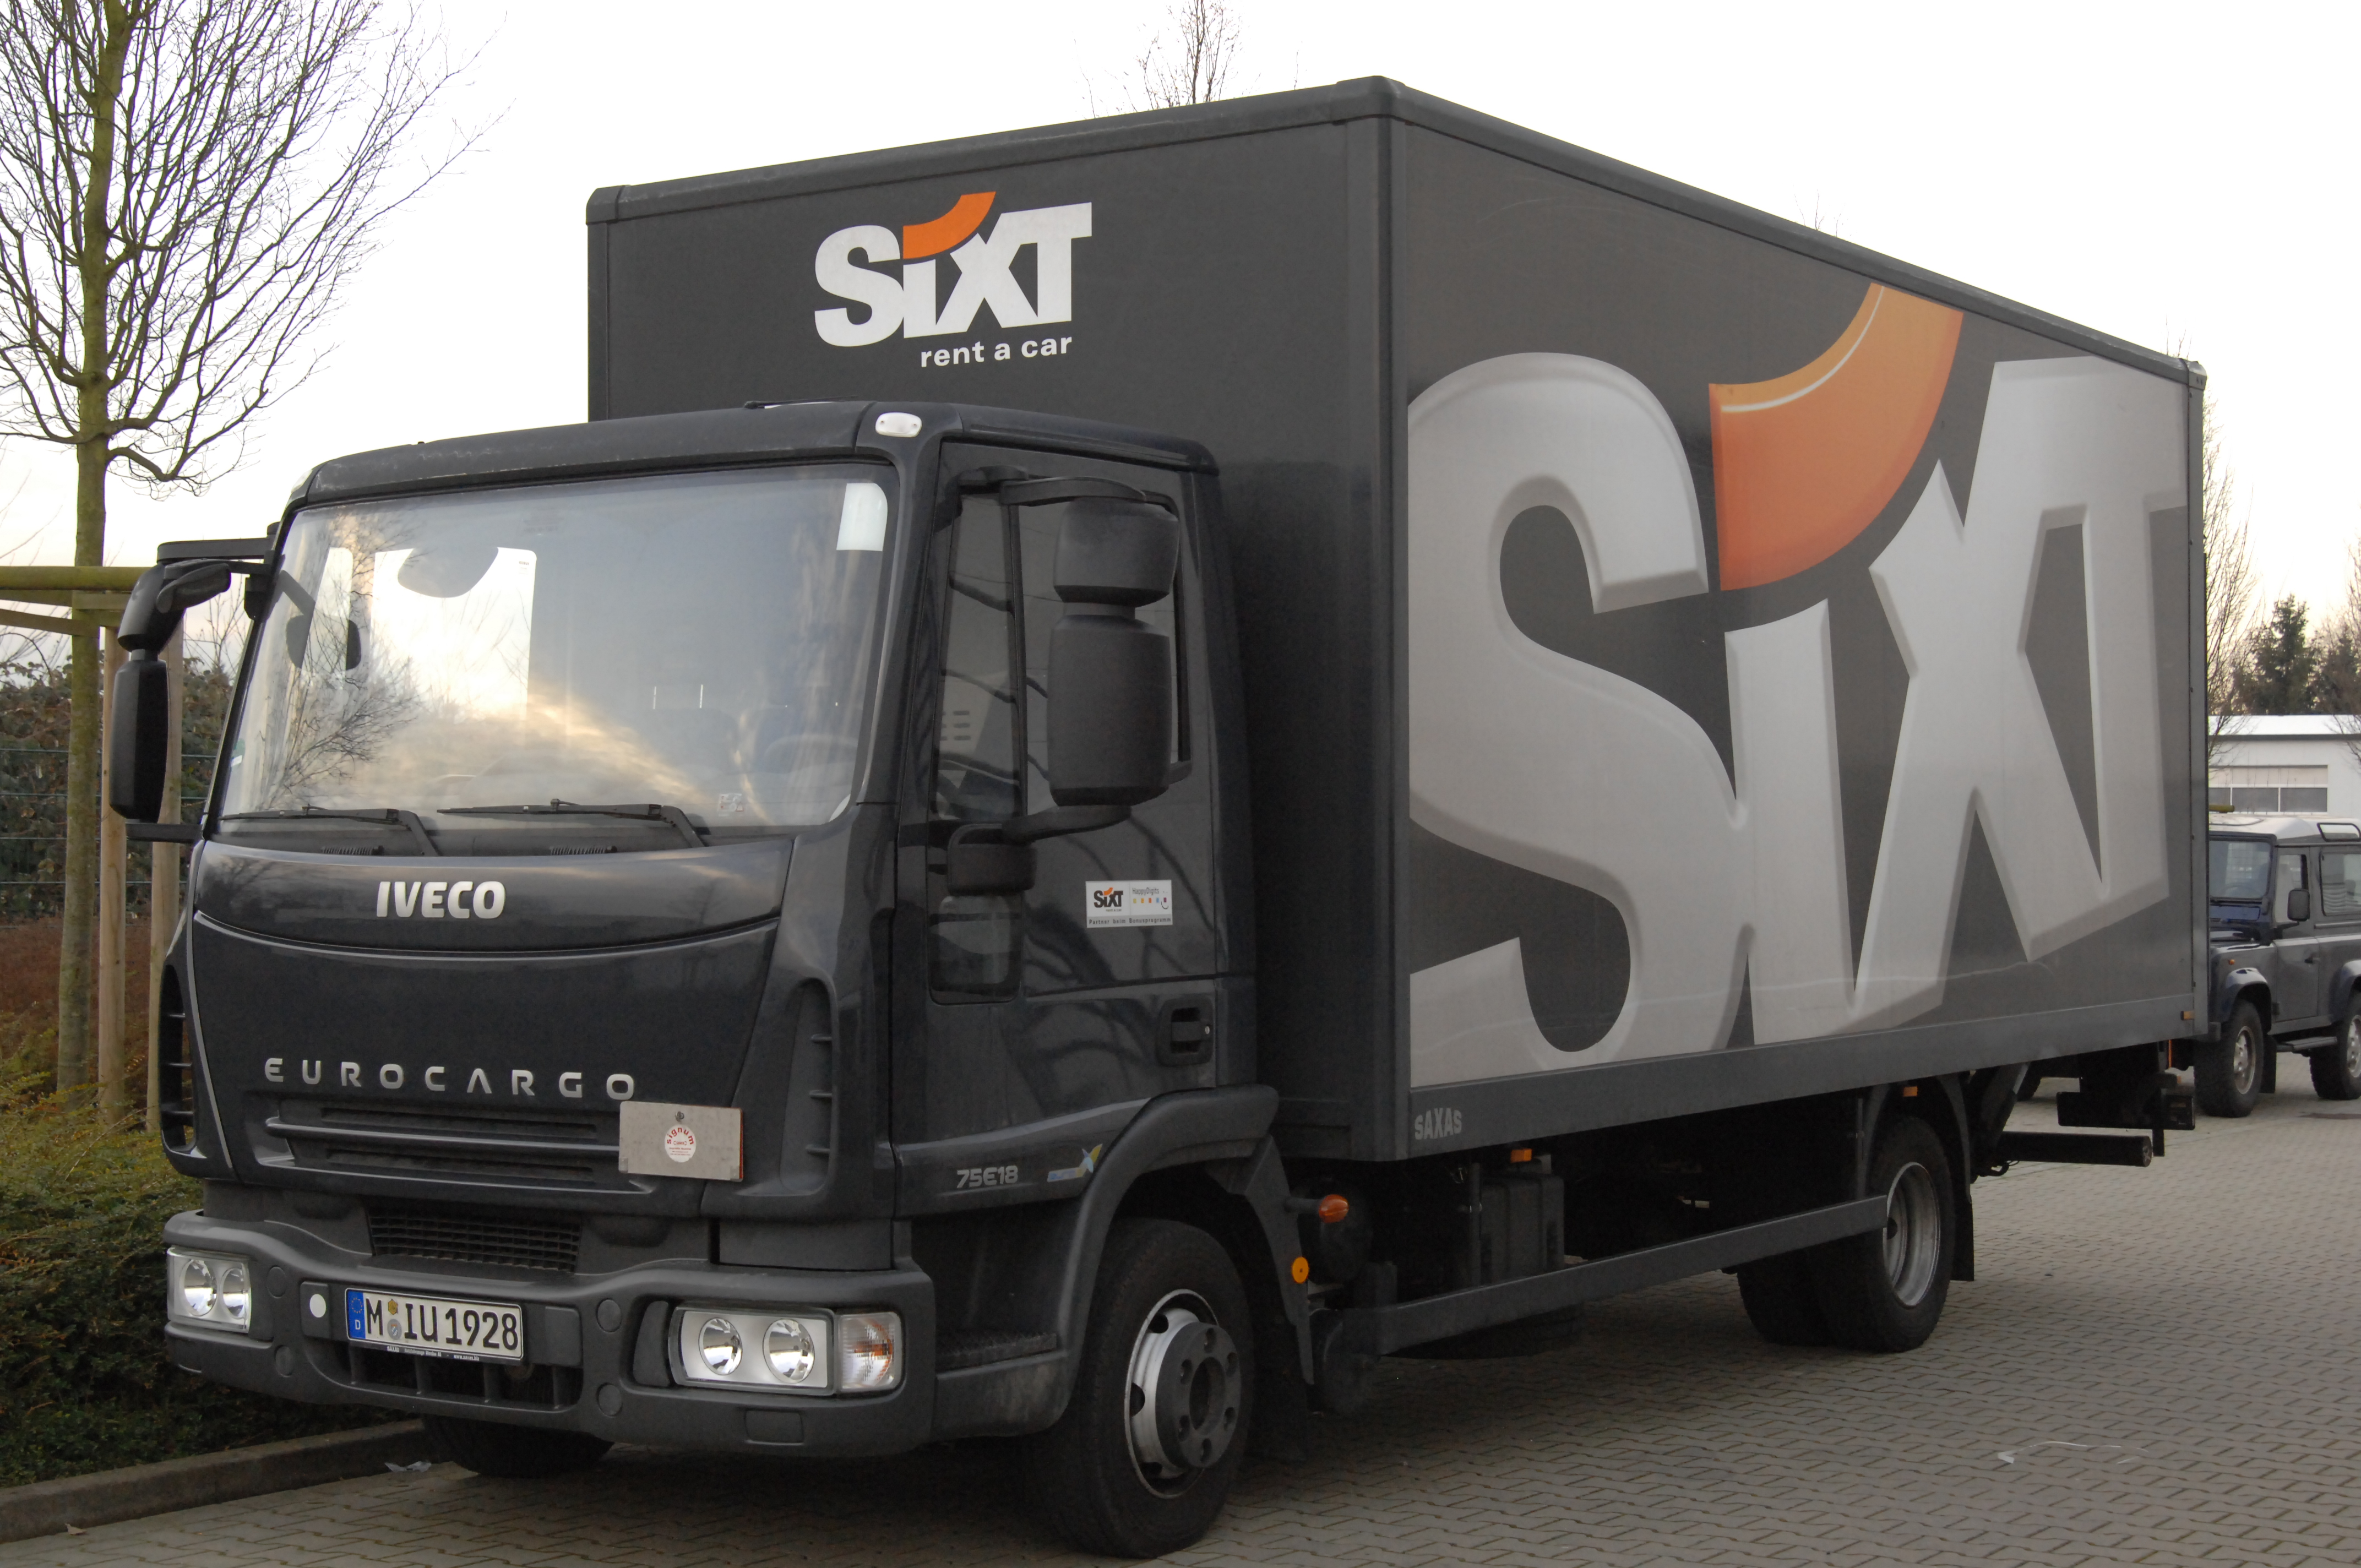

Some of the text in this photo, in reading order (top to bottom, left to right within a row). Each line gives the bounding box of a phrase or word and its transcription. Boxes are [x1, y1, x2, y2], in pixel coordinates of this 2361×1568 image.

[920, 336, 1072, 367] rent a car
[376, 881, 506, 919] IVECO
[1132, 887, 1159, 896] HappyDigits
[264, 1057, 635, 1100] EUROCARGO
[667, 1127, 694, 1145] signum
[1415, 1107, 1462, 1140] SAXAS
[956, 1165, 1018, 1188] 75E18
[355, 1320, 361, 1330] D
[366, 1298, 383, 1336] M
[445, 1308, 518, 1350] 1928
